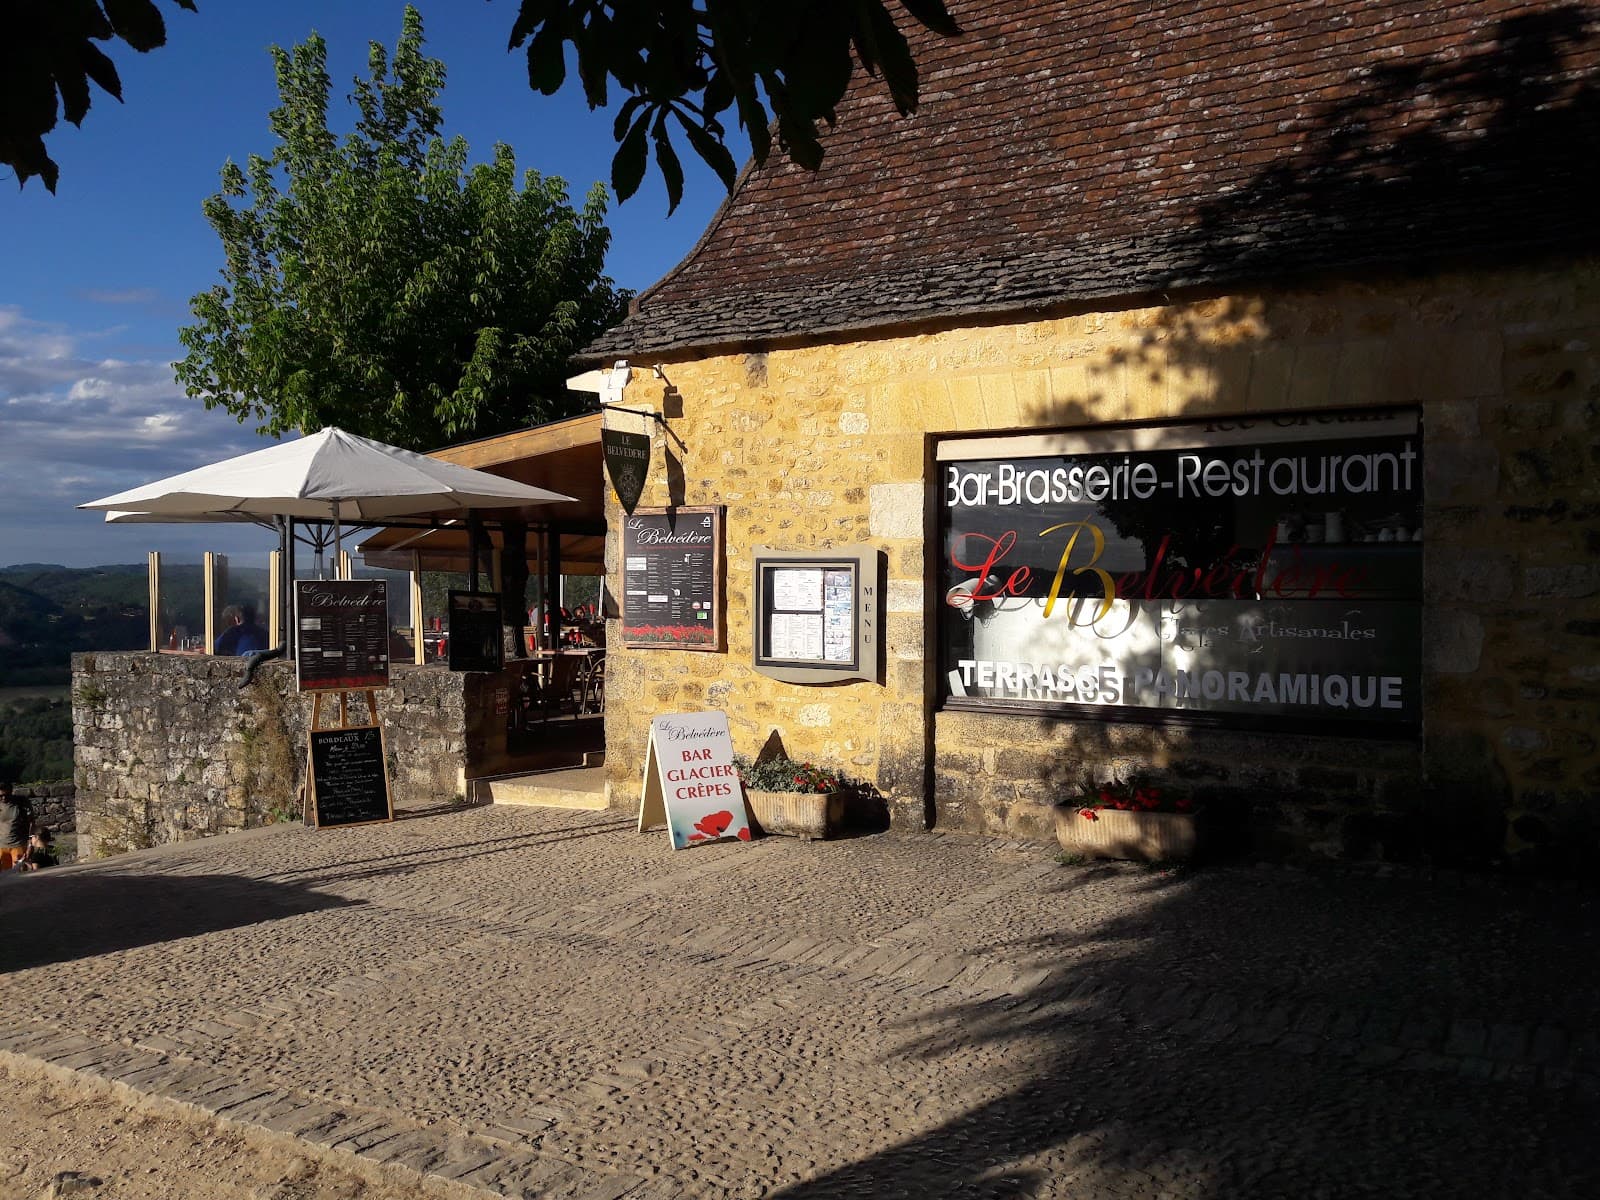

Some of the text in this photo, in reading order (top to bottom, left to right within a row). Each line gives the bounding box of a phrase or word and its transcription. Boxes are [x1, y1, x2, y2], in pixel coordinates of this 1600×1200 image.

[627, 518, 644, 530] Le
[636, 527, 712, 545] Belvédère
[946, 530, 1034, 607] Le
[863, 587, 873, 644] MENU
[957, 659, 1403, 710] TERRASSE PANORAMIQUE
[659, 720, 673, 731] Le
[668, 726, 726, 741] Belvédère
[318, 735, 360, 745] BORDEAUX
[681, 748, 713, 762] BAR
[666, 764, 734, 782] GLACIER
[675, 782, 732, 800] CRÊPES
